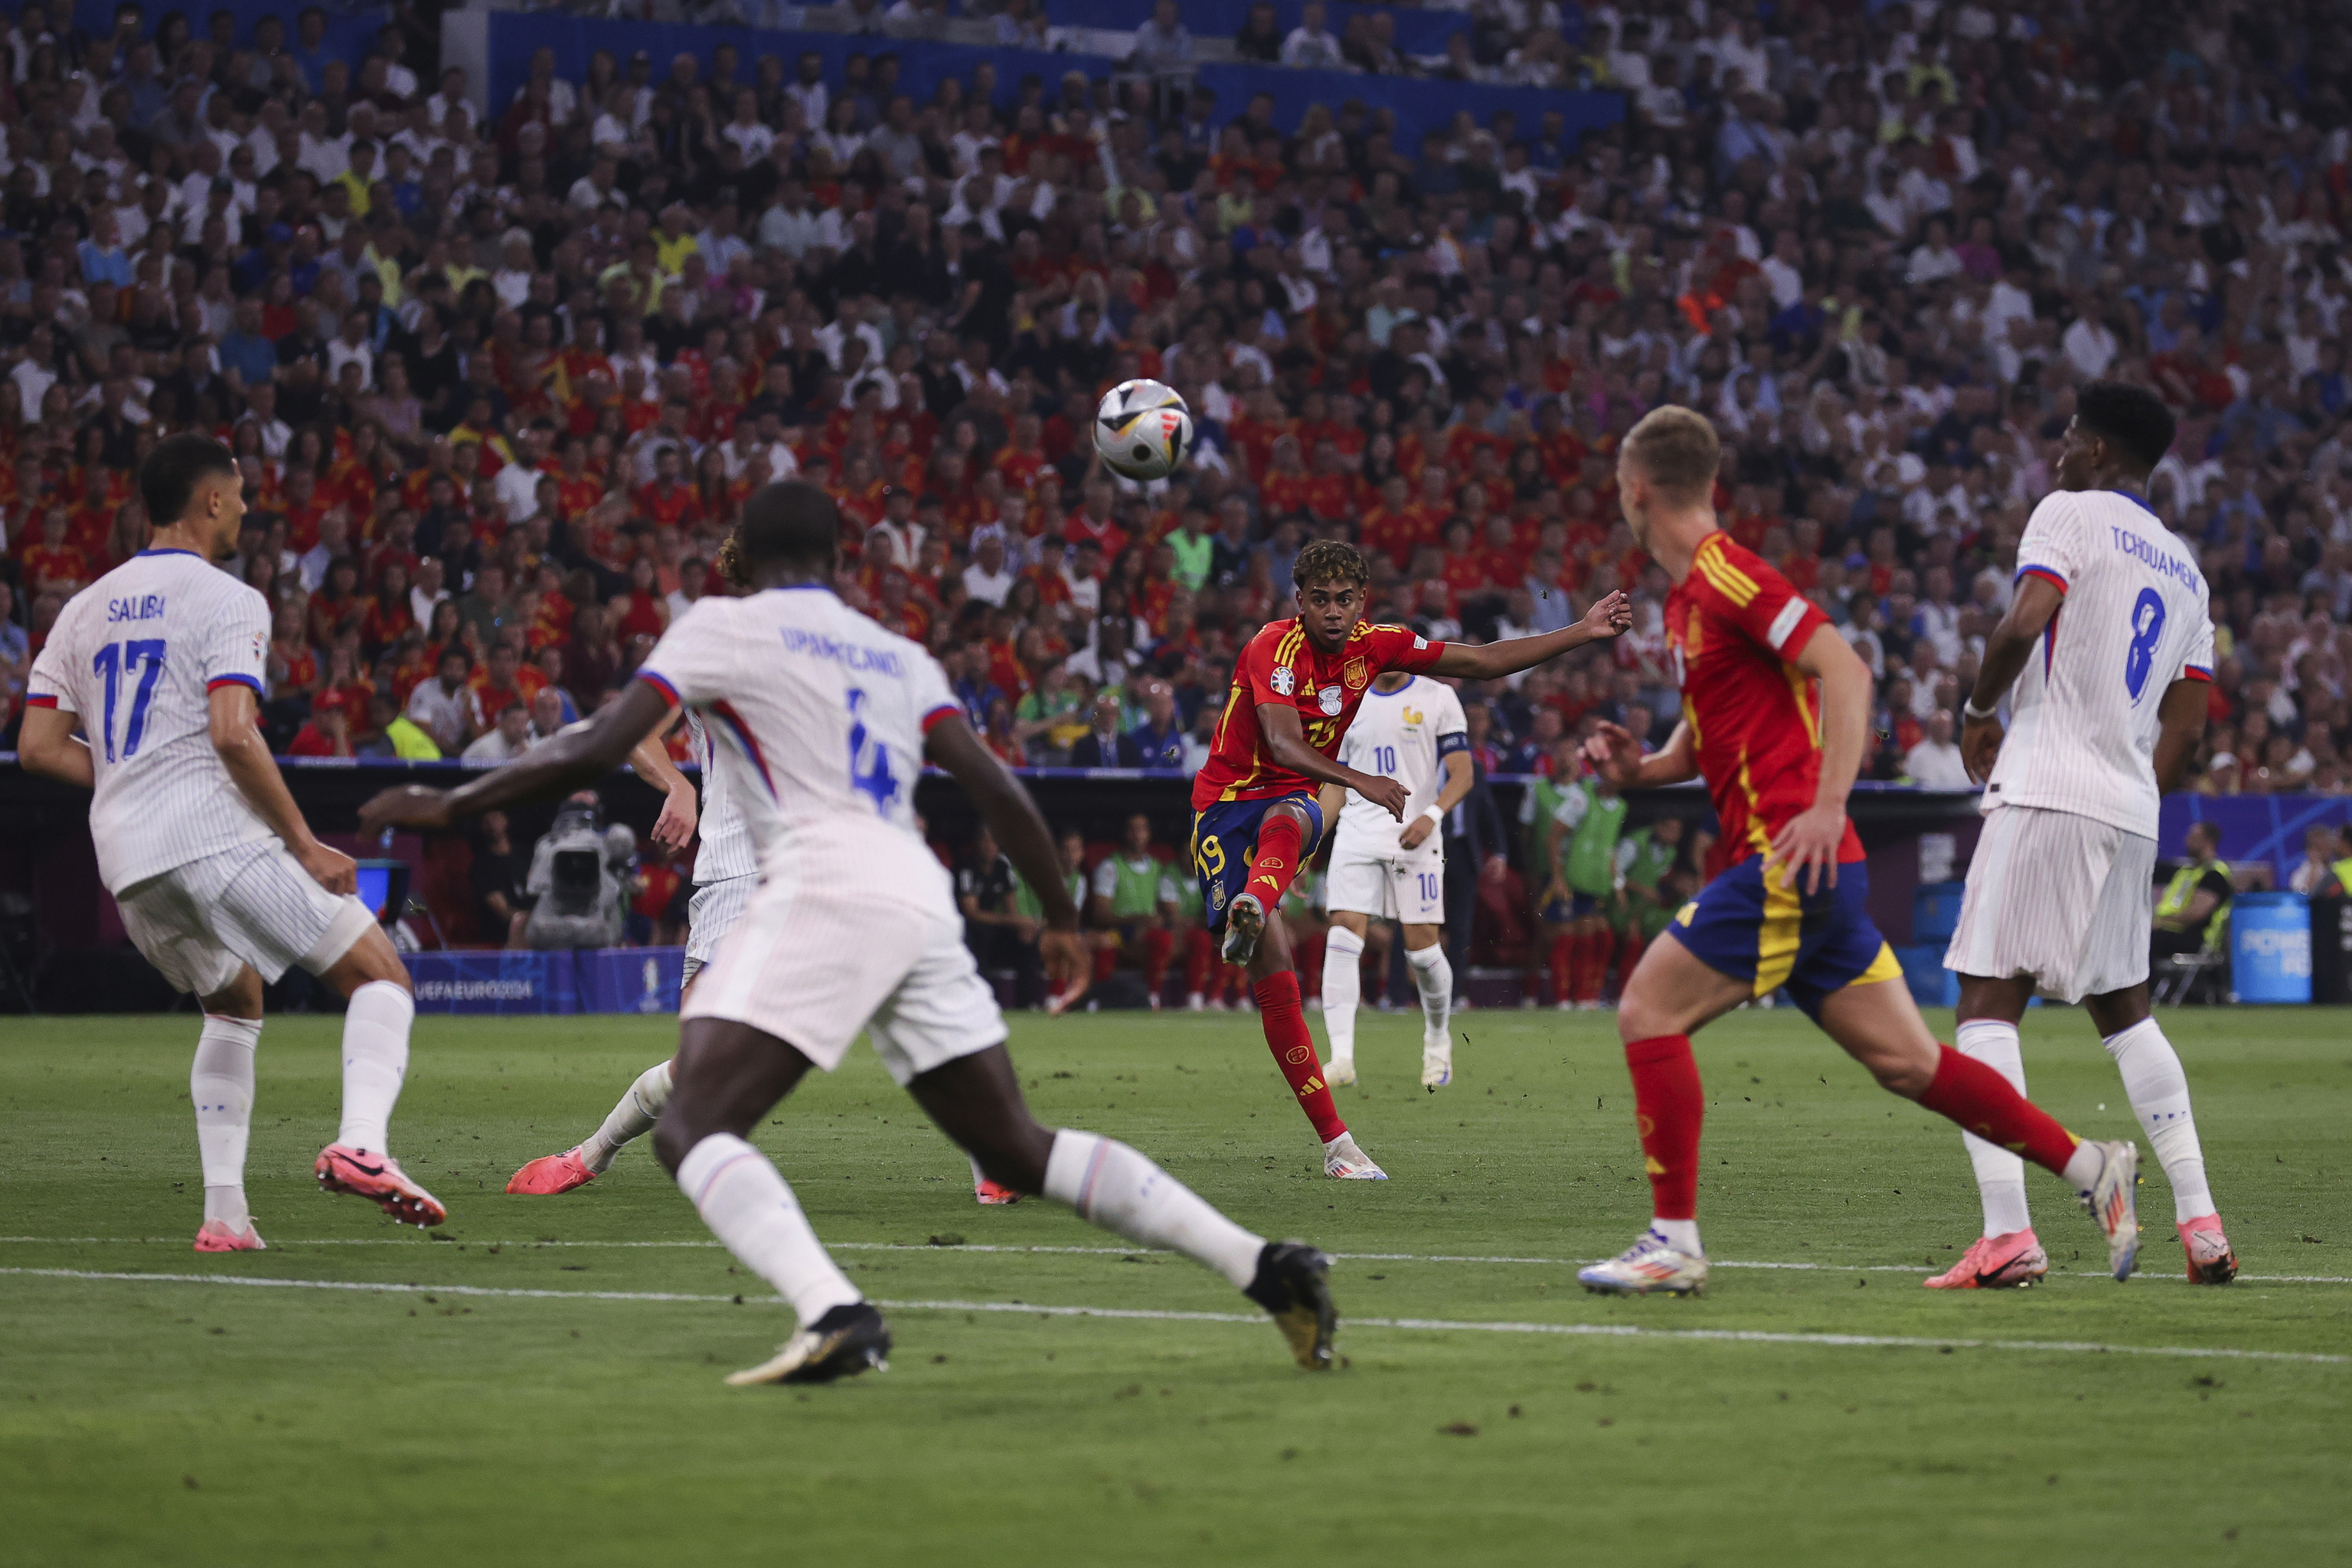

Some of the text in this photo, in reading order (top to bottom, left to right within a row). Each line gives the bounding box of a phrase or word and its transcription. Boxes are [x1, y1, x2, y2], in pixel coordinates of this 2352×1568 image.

[108, 595, 166, 623] SALIBA
[2125, 586, 2166, 704] 8
[93, 639, 166, 763] 17
[847, 688, 901, 822] 4
[1374, 746, 1396, 773] 10
[1197, 835, 1226, 880] 19
[1417, 873, 1438, 900] 10
